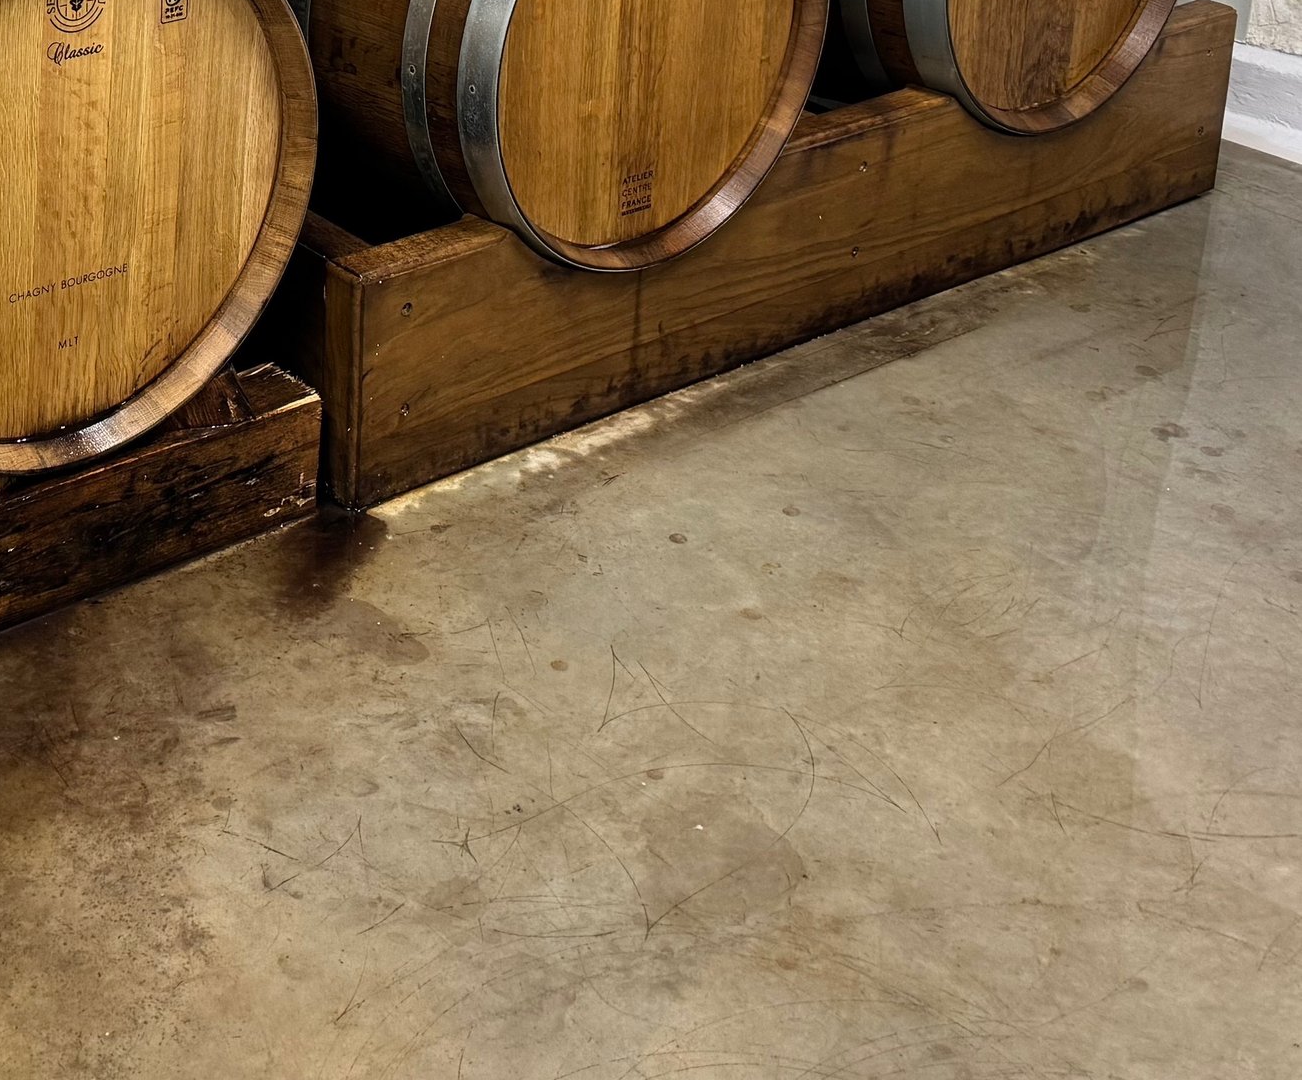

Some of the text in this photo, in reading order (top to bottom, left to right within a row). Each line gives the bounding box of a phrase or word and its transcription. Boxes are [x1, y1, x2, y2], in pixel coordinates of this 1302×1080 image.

[46, 41, 104, 67] Classic
[622, 170, 654, 185] ATELIER
[621, 183, 652, 198] CENTRE
[621, 195, 652, 210] FRANCE
[8, 263, 128, 304] CHAGNY BOURGOGNE
[58, 336, 79, 350] MLT
